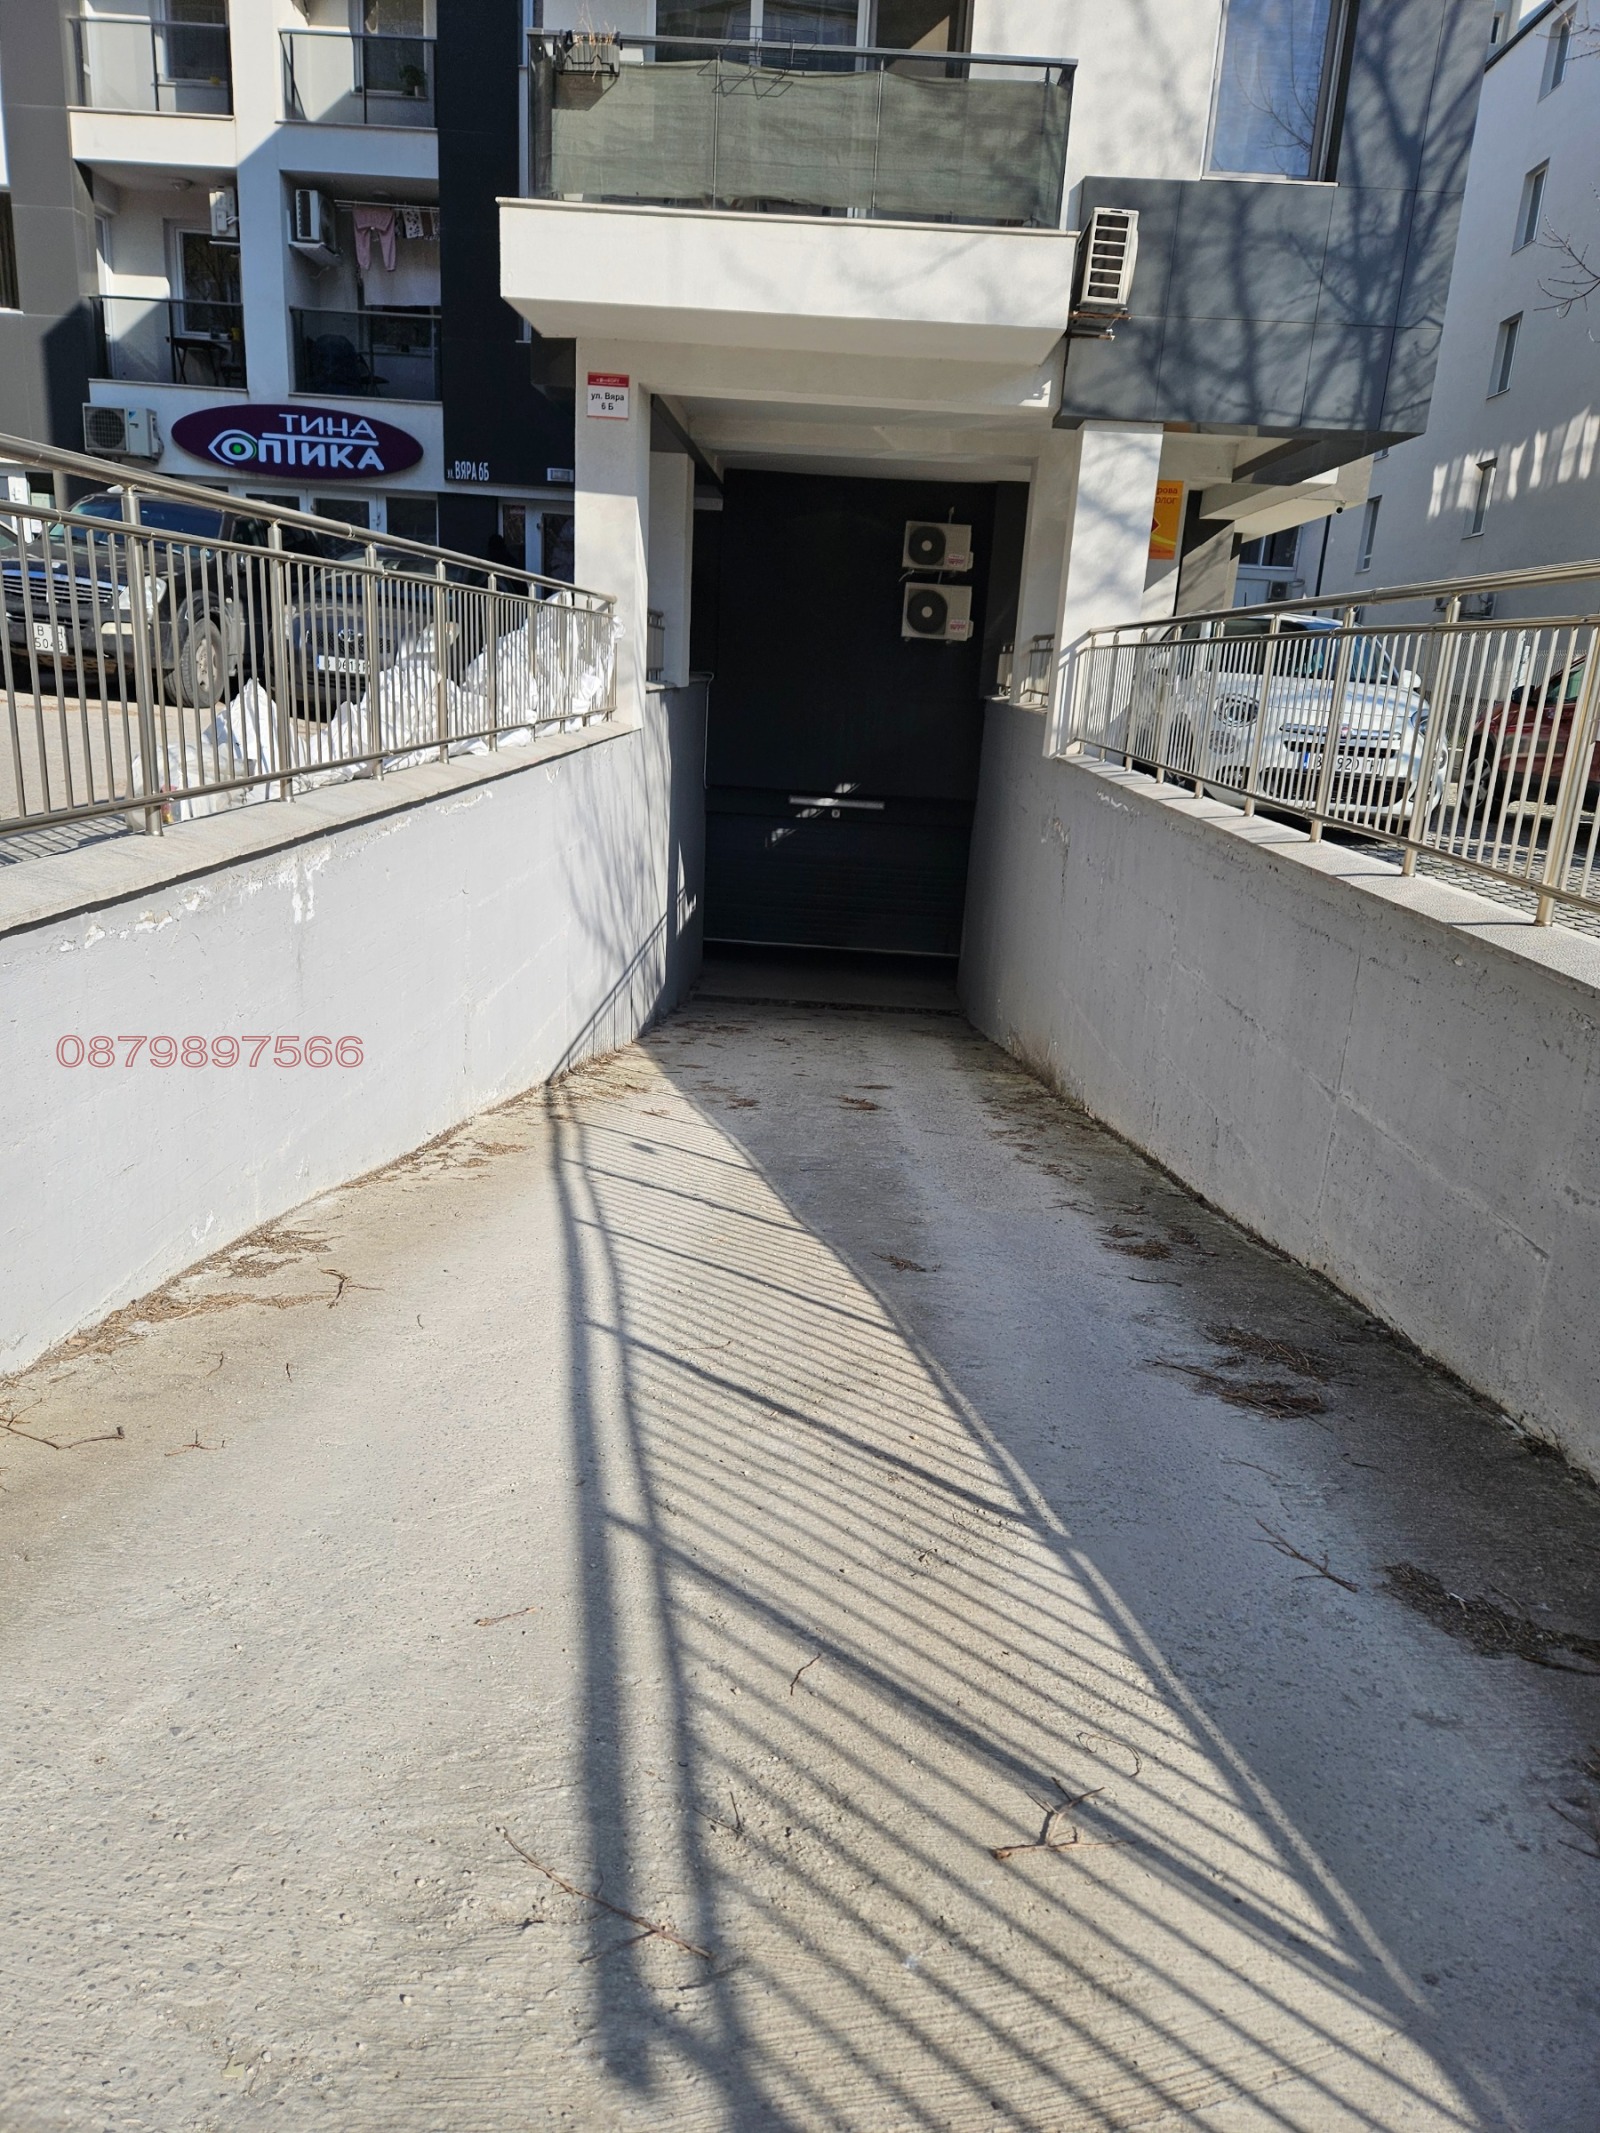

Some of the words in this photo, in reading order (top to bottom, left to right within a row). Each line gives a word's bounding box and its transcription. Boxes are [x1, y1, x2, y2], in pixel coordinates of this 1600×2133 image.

[591, 392, 602, 401] ул.
[605, 392, 625, 402] Вяра
[601, 402, 606, 410] 6
[608, 402, 614, 410] Б
[278, 413, 377, 438] ТИНА
[220, 432, 385, 471] ОПТИКА
[455, 460, 477, 480] ВЯРА
[478, 462, 490, 481] 6Б
